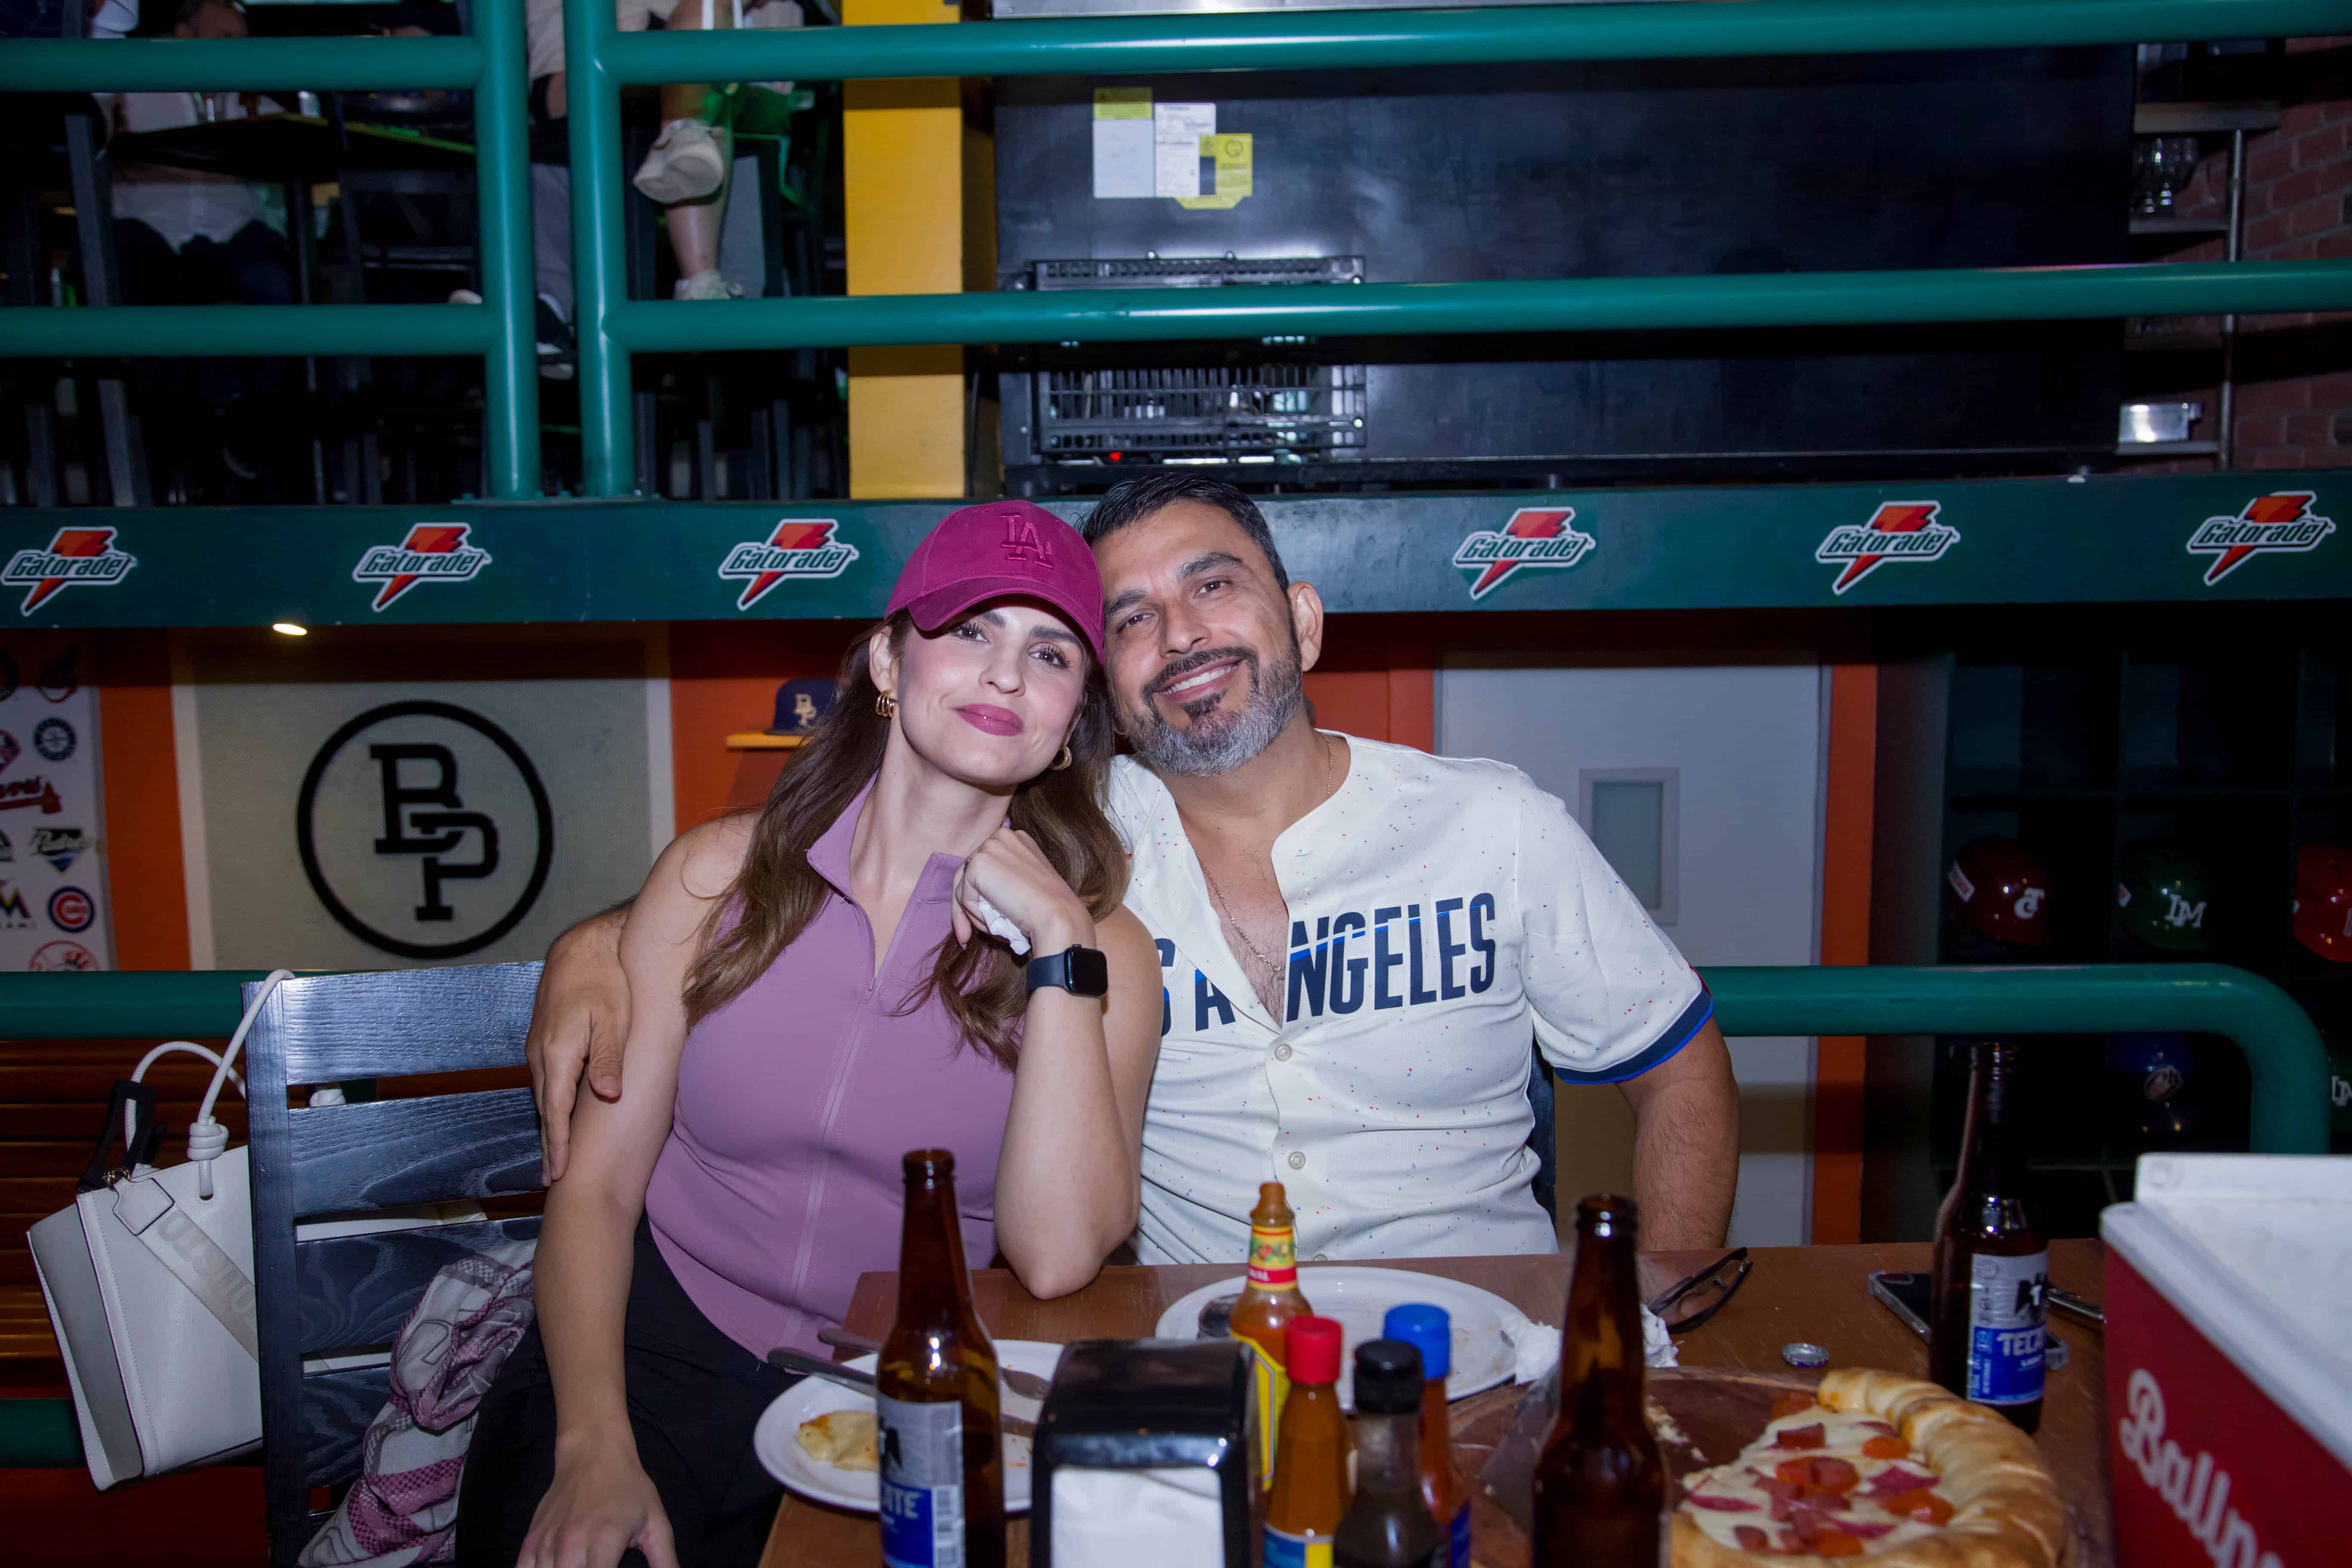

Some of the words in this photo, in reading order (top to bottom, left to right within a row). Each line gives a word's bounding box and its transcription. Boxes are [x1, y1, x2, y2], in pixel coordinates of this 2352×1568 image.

[998, 512, 1053, 569] LA
[1827, 530, 1944, 553] Gatorade
[2197, 521, 2318, 544] Gatorade
[729, 547, 843, 569] Gatorade
[1463, 536, 1580, 558] Gatorade
[11, 555, 122, 576] Gatorade
[364, 551, 476, 572] Gatorade
[369, 743, 499, 922] BP
[1195, 892, 1495, 1032] ANGELES
